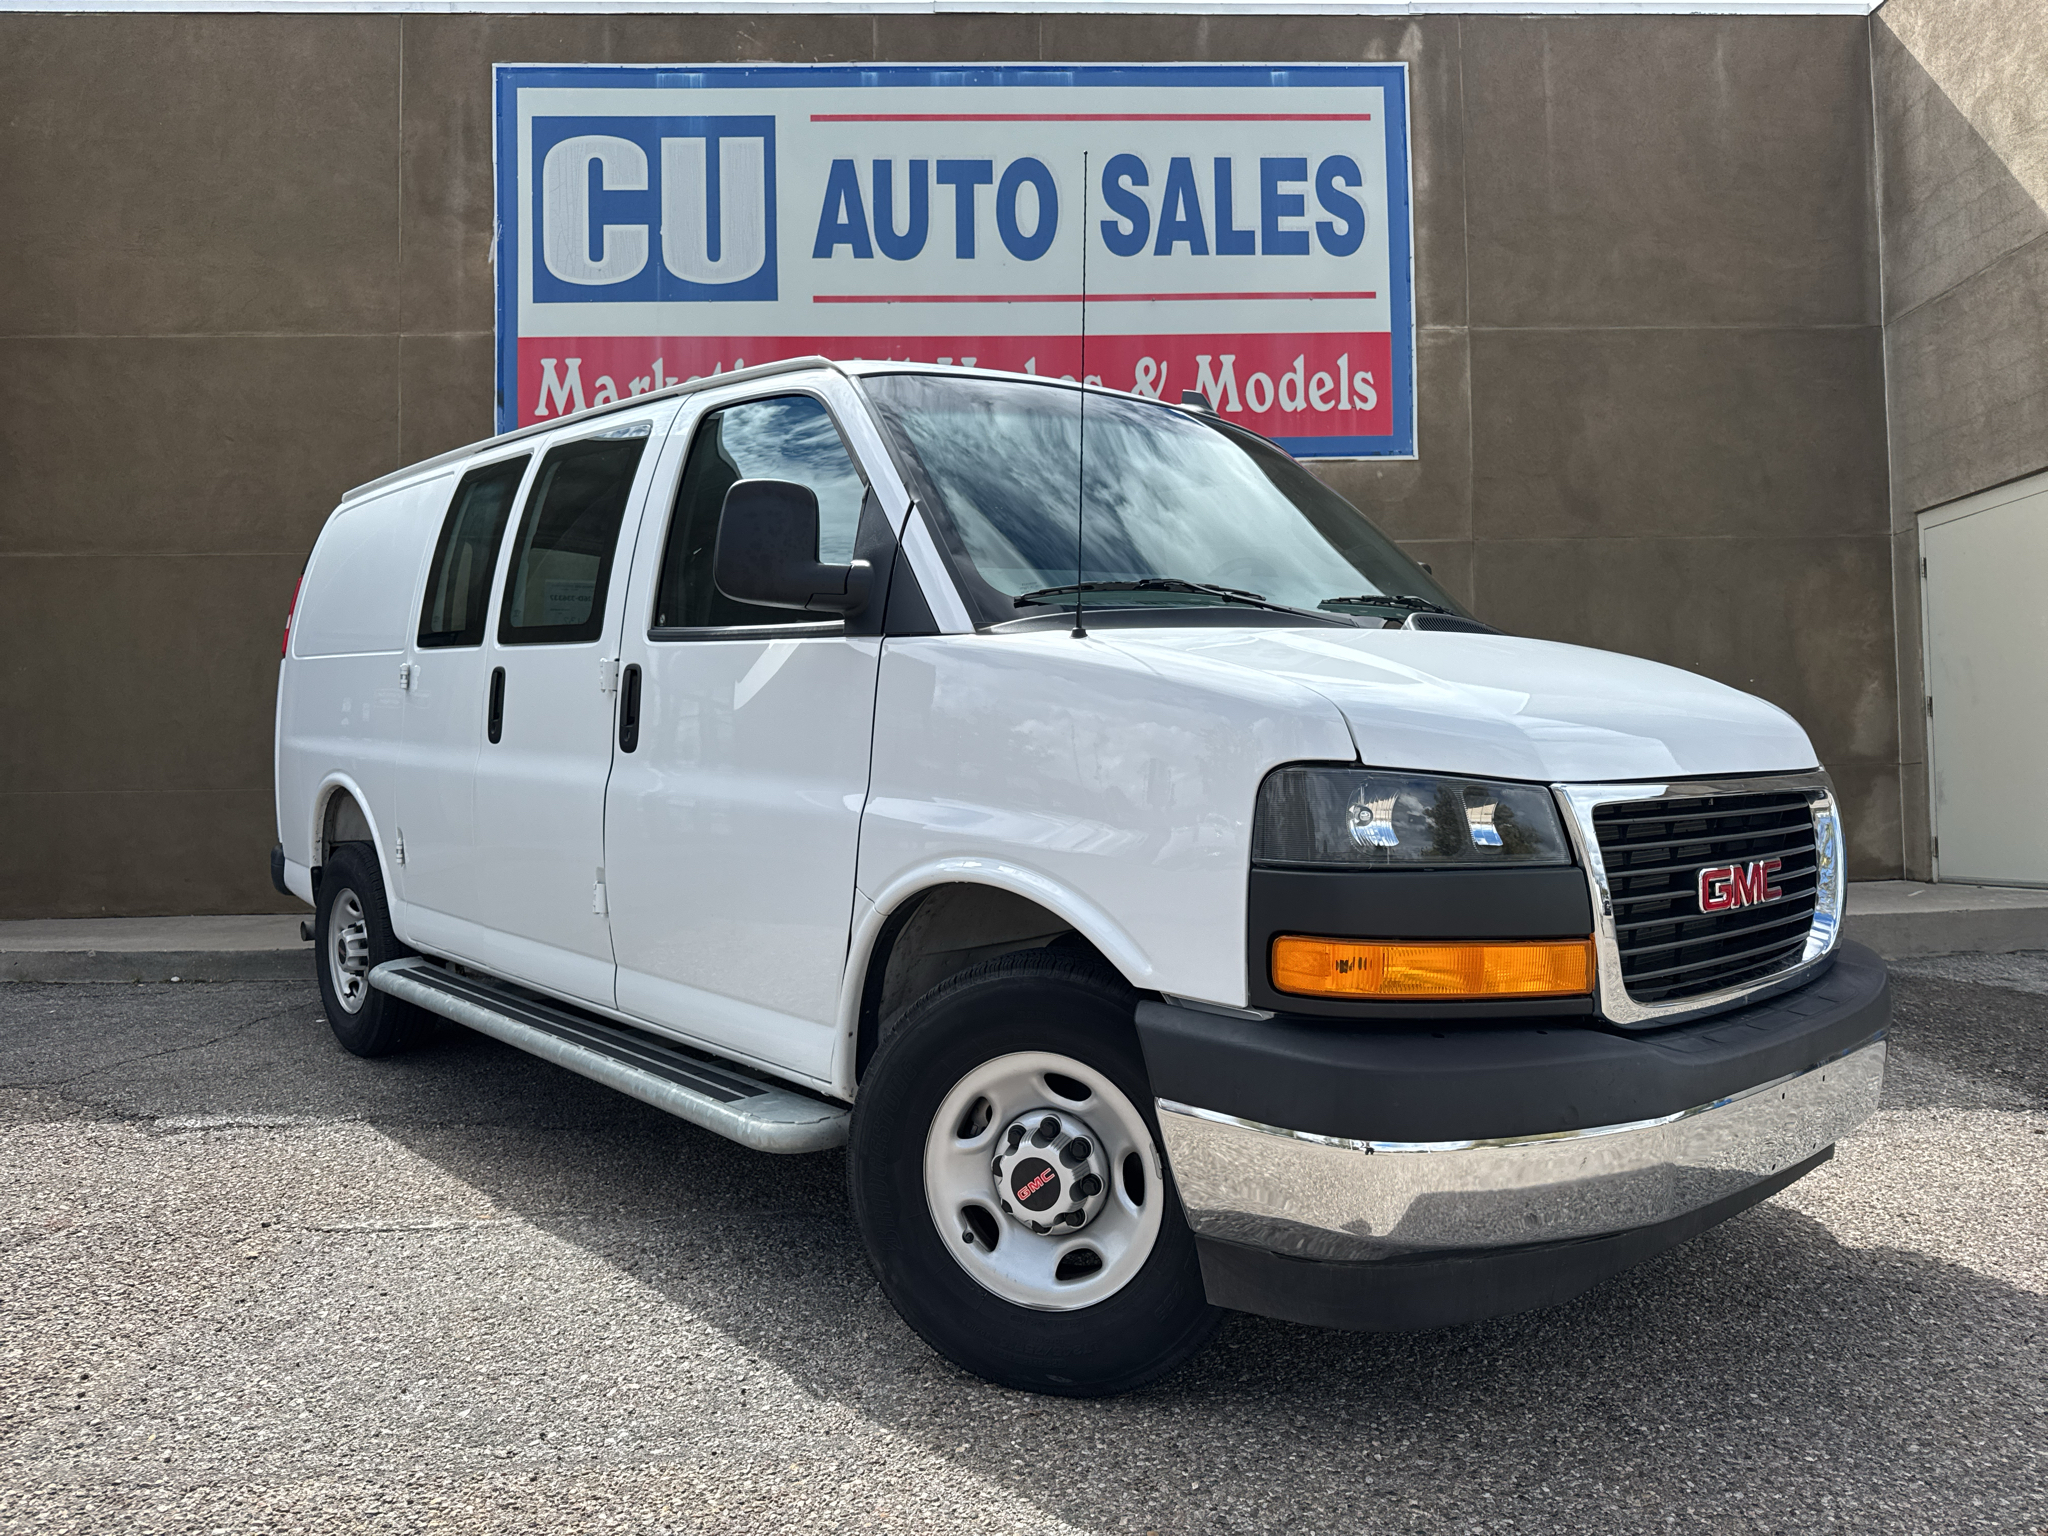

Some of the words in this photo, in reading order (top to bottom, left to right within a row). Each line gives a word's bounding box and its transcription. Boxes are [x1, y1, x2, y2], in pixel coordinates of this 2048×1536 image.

[543, 134, 766, 285] CU
[811, 156, 1060, 262] AUTO
[1099, 153, 1366, 258] SALES
[1195, 352, 1378, 413] Models
[1698, 857, 1782, 914] GMC
[868, 1056, 918, 1251] BRIDGESTONE
[1017, 1167, 1056, 1201] GMC
